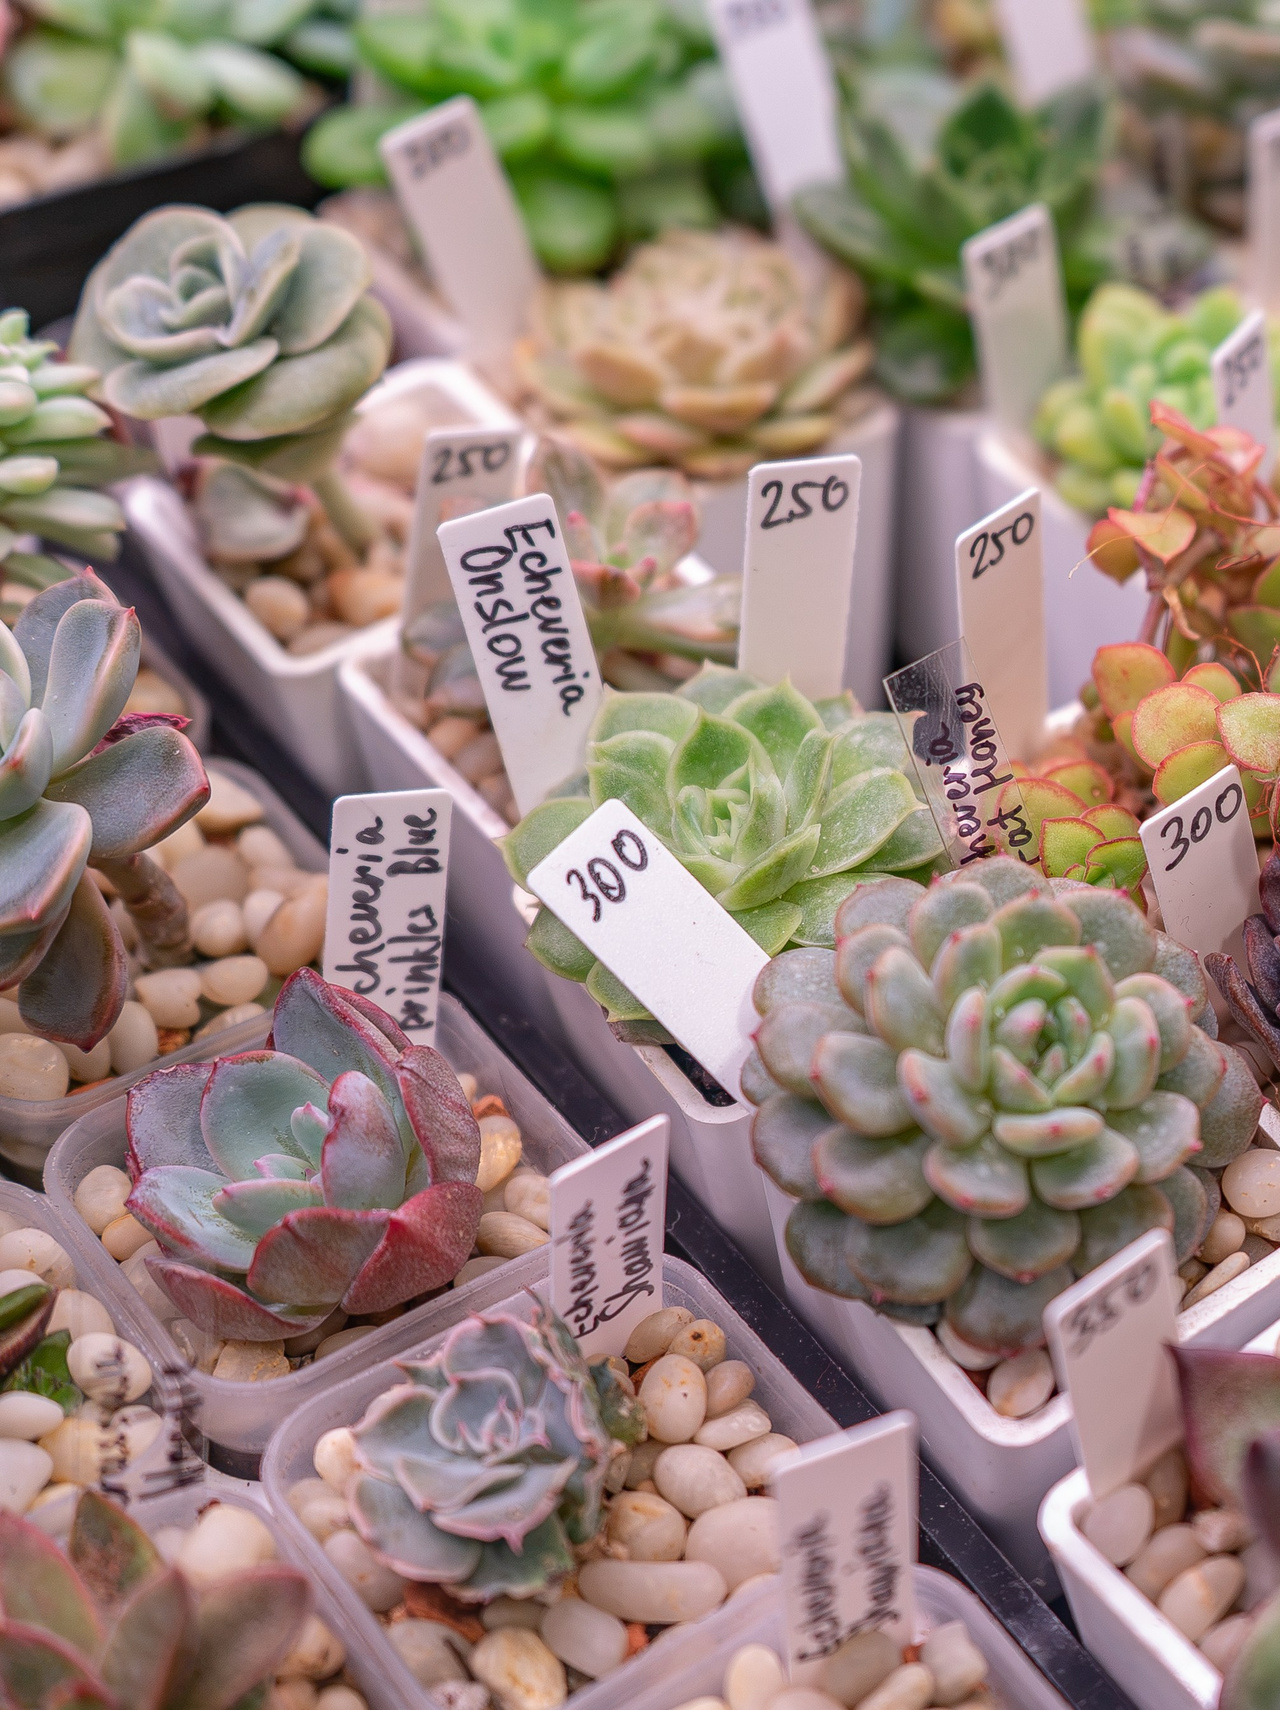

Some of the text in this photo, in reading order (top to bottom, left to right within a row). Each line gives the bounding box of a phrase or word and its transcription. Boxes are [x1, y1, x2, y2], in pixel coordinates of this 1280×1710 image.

[430, 441, 511, 485] 250
[761, 475, 849, 529] 250
[969, 512, 1035, 579] 250
[459, 545, 532, 692] Onslow
[503, 518, 590, 717] Echeveria
[926, 722, 996, 865] heveria
[955, 682, 1014, 795] Honey
[566, 829, 648, 922] 300
[1160, 783, 1243, 872] 300
[335, 816, 386, 995] cheveria
[385, 806, 443, 1031] prinkles Blue
